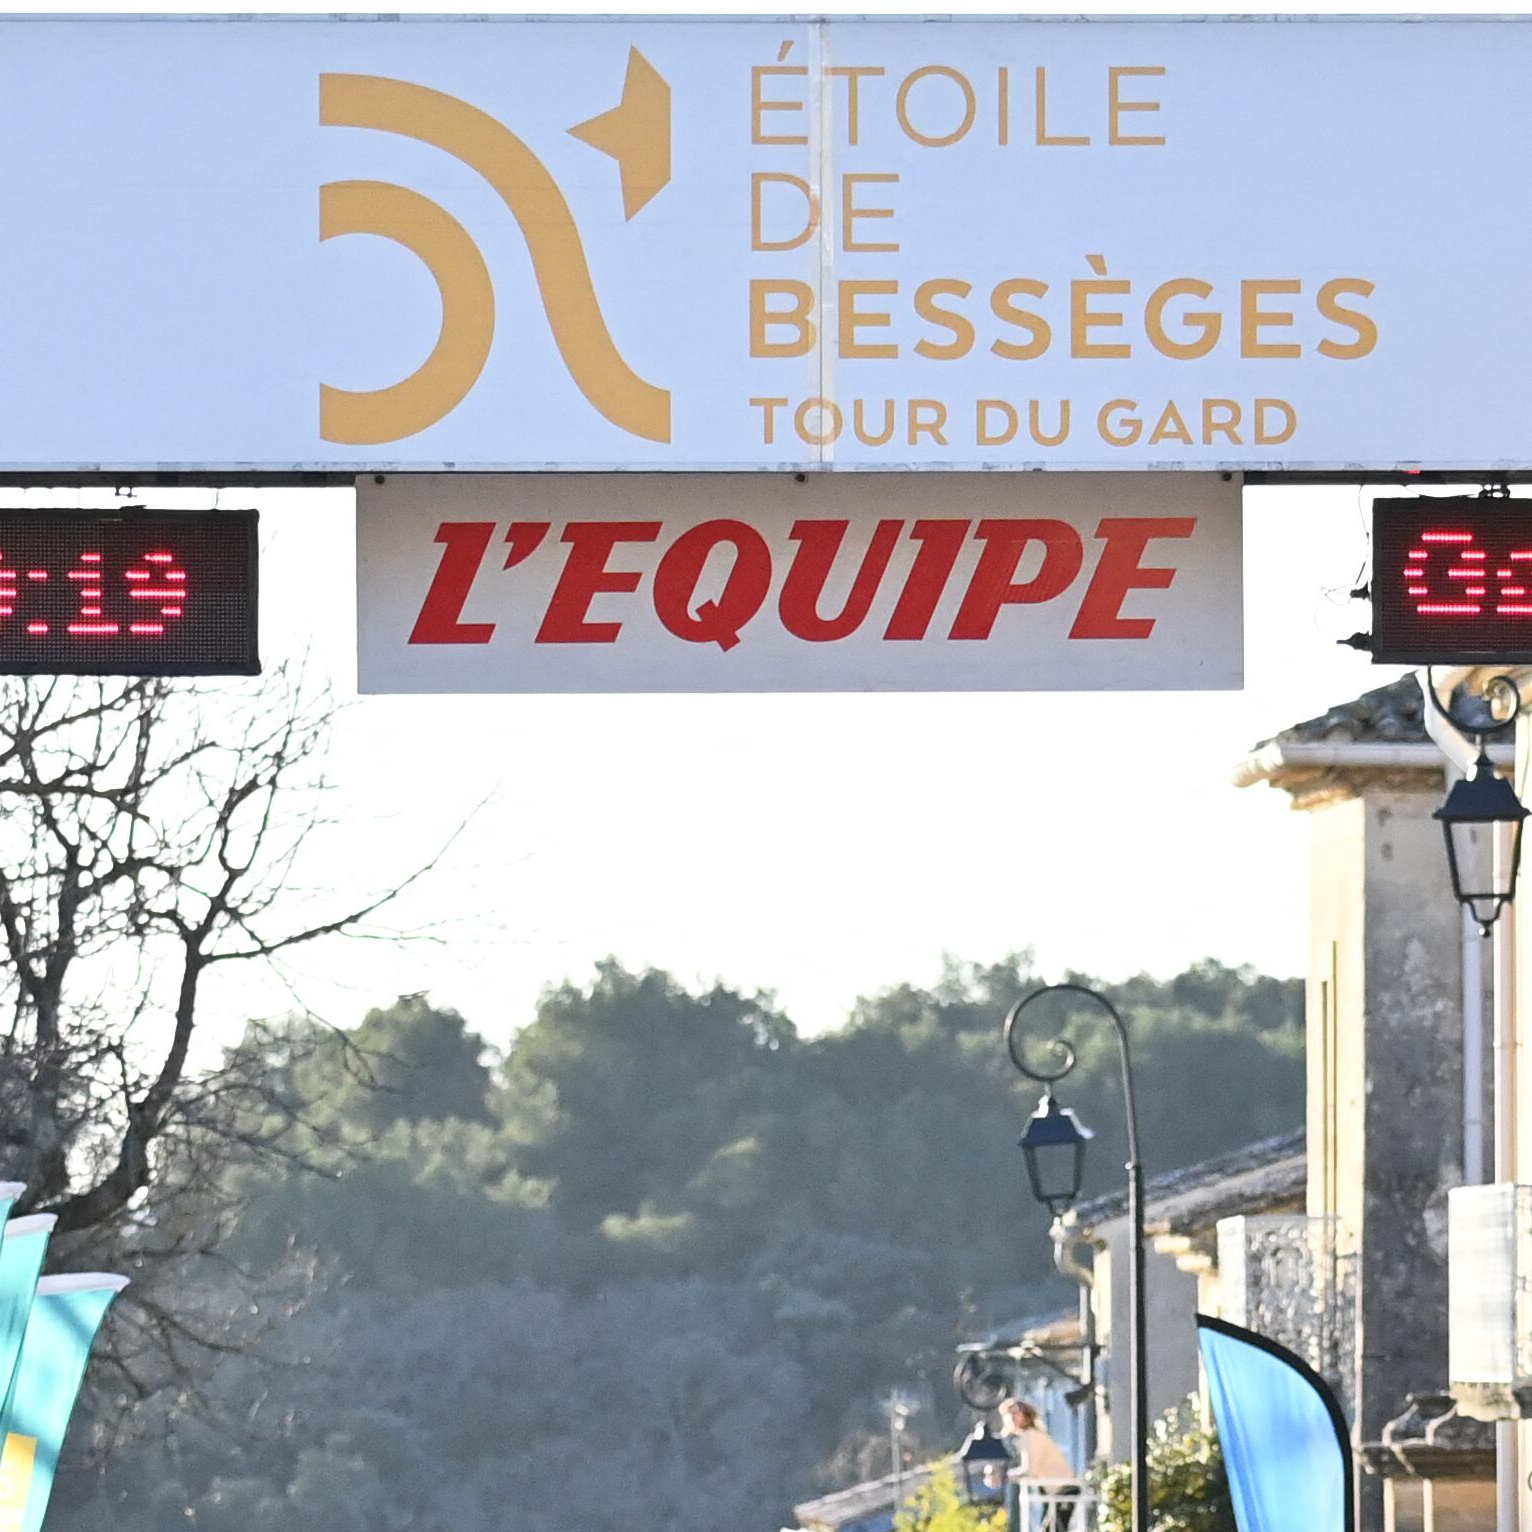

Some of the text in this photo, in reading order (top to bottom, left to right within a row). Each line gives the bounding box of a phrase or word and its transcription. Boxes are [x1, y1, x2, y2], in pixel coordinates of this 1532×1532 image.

[751, 40, 1167, 148] ÉTOILE
[751, 172, 900, 253] DE
[749, 254, 1378, 361] BESSÈGES
[749, 399, 1298, 447] TOUR DU GARD
[406, 517, 1198, 652] L'EQUIPE
